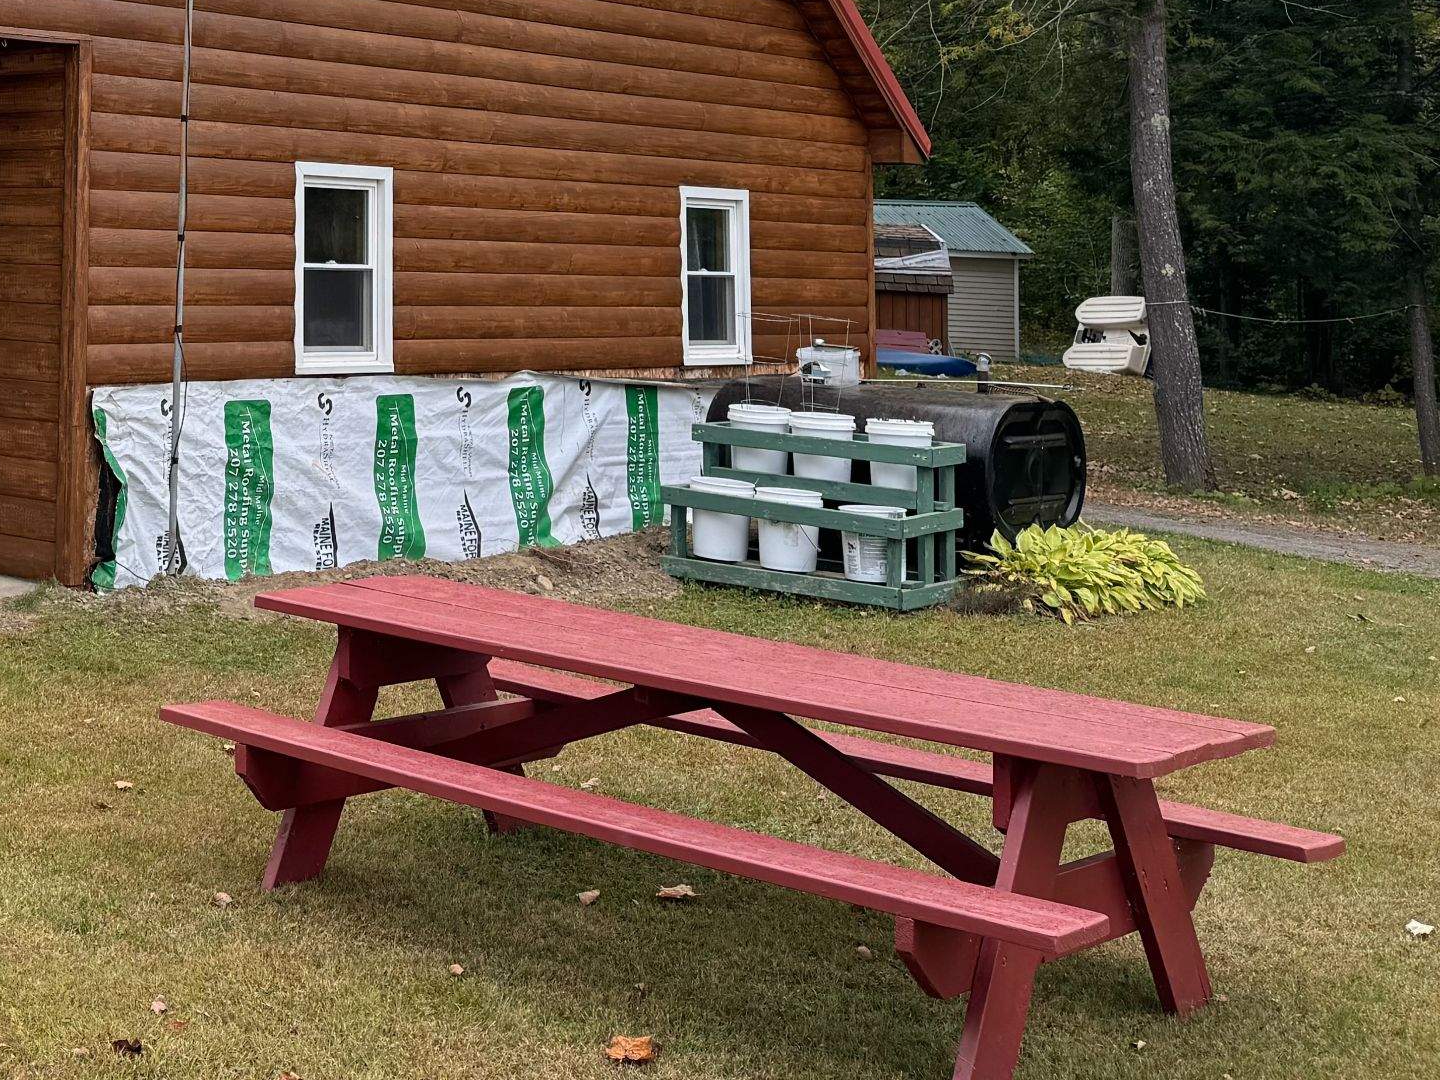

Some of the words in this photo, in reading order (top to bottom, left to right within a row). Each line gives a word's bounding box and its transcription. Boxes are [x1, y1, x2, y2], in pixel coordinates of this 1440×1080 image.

[520, 404, 530, 443] Metal
[637, 393, 645, 430] Metal
[241, 420, 252, 463] Metal
[390, 414, 399, 454] Metal
[511, 428, 519, 456] 207
[228, 448, 241, 476] 207
[376, 439, 388, 468] 207
[531, 452, 539, 471] Mid
[628, 446, 637, 472] 278
[637, 433, 646, 484] Roofing
[254, 475, 266, 493] Mid
[376, 473, 387, 502] 278
[388, 458, 399, 514] Roofing
[400, 465, 408, 483] Mid
[510, 460, 521, 488] 278
[521, 446, 535, 500] Roofing
[534, 471, 546, 499] Maine
[228, 482, 239, 512] 278
[239, 468, 254, 526] Roofing
[401, 484, 409, 514] Maine
[583, 486, 595, 515] MAINE
[629, 476, 640, 510] 2520
[639, 486, 650, 528] Supply
[254, 495, 264, 526] Maine
[382, 506, 395, 543] 2520
[456, 510, 464, 534] REAL
[460, 504, 476, 536] MAINE
[515, 491, 529, 529] 2520
[227, 517, 238, 559] 2520
[313, 523, 321, 548] REAL
[319, 517, 332, 550] MAINE
[394, 518, 406, 559] Suppl
[466, 538, 477, 559] FOR
[322, 552, 334, 569] FO
